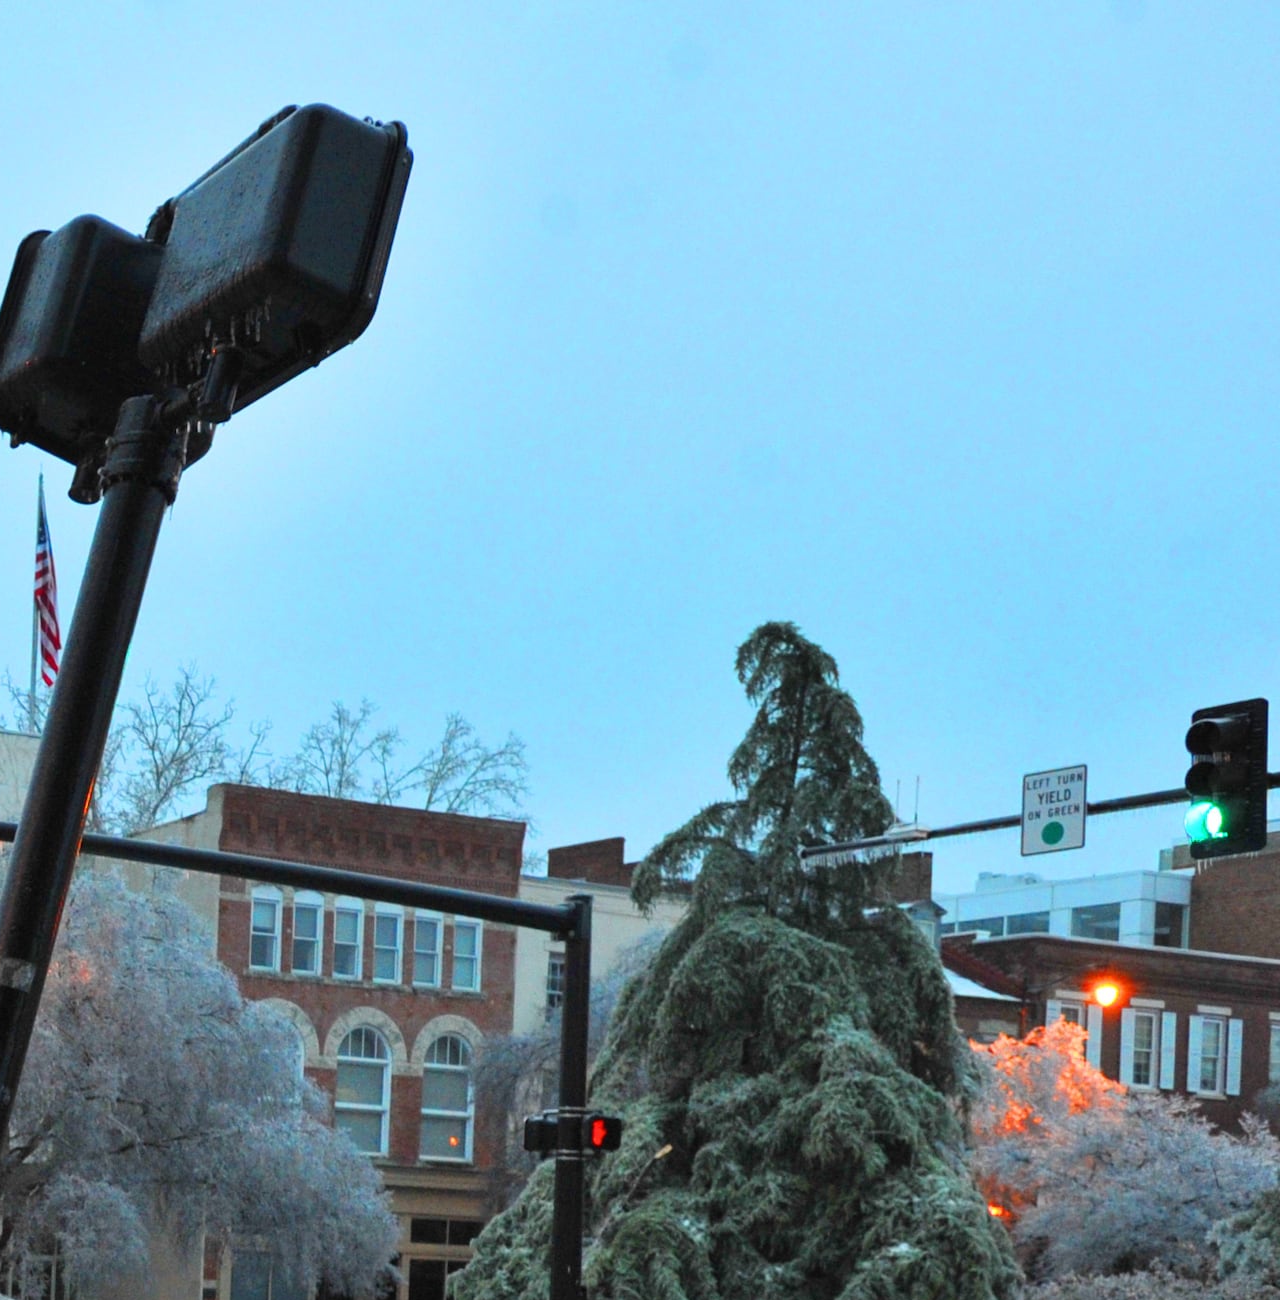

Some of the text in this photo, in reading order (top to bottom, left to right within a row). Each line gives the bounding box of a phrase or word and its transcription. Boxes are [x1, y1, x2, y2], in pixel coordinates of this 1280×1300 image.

[1026, 772, 1083, 790] LEFT TURN
[1038, 788, 1072, 805] YIELD
[1027, 803, 1080, 821] ON GREEN
